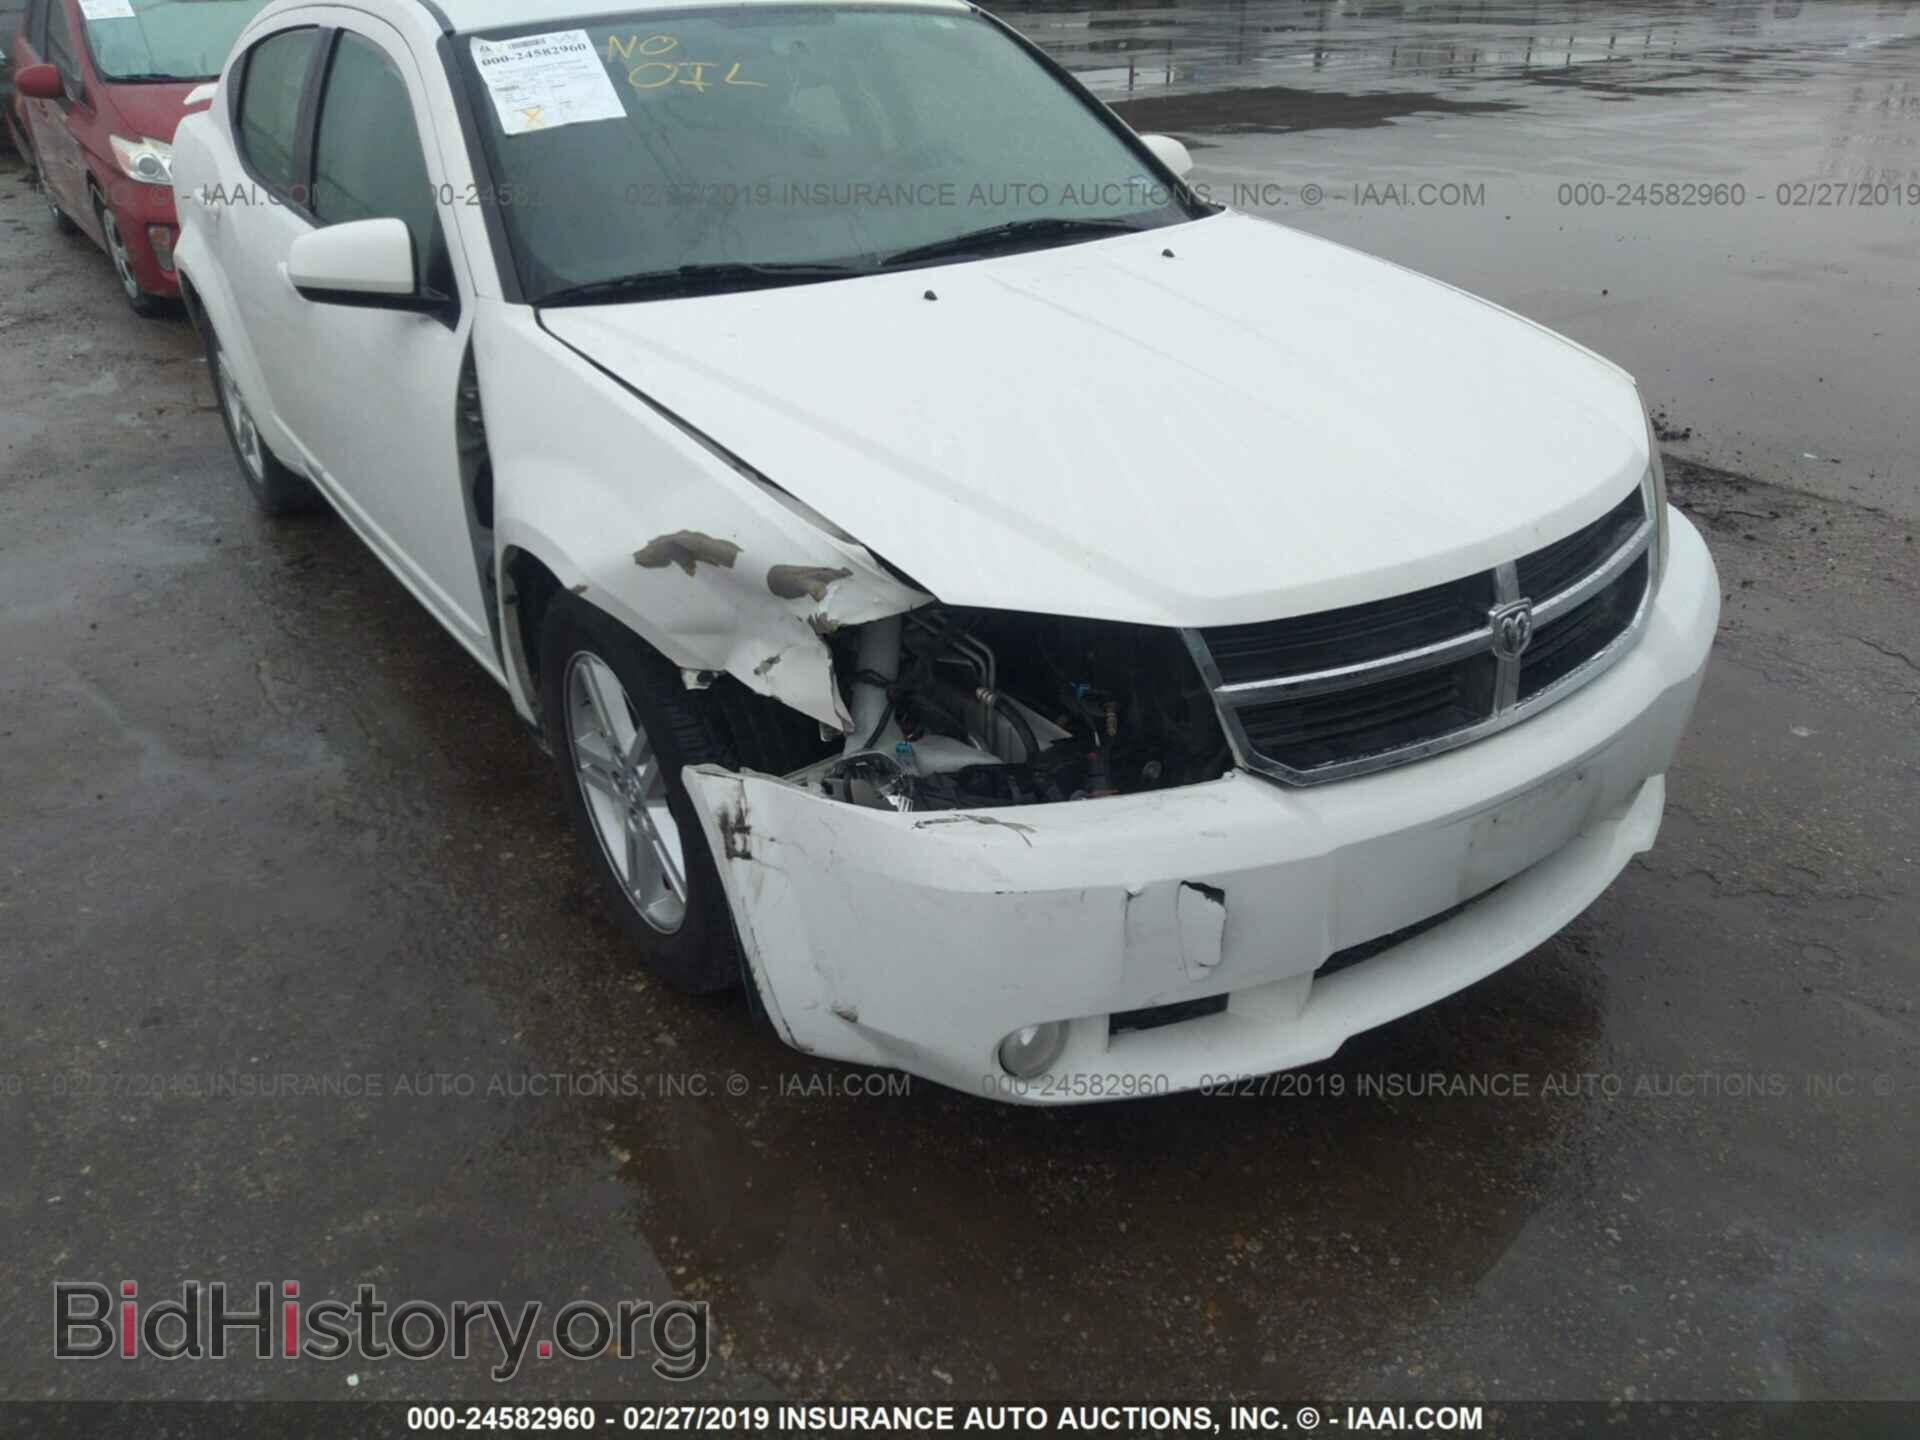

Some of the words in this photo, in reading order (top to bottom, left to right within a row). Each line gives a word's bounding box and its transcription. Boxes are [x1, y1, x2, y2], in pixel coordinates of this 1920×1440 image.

[481, 42, 588, 67] 000-24582960
[607, 34, 679, 64] NO
[628, 62, 769, 92] OIL
